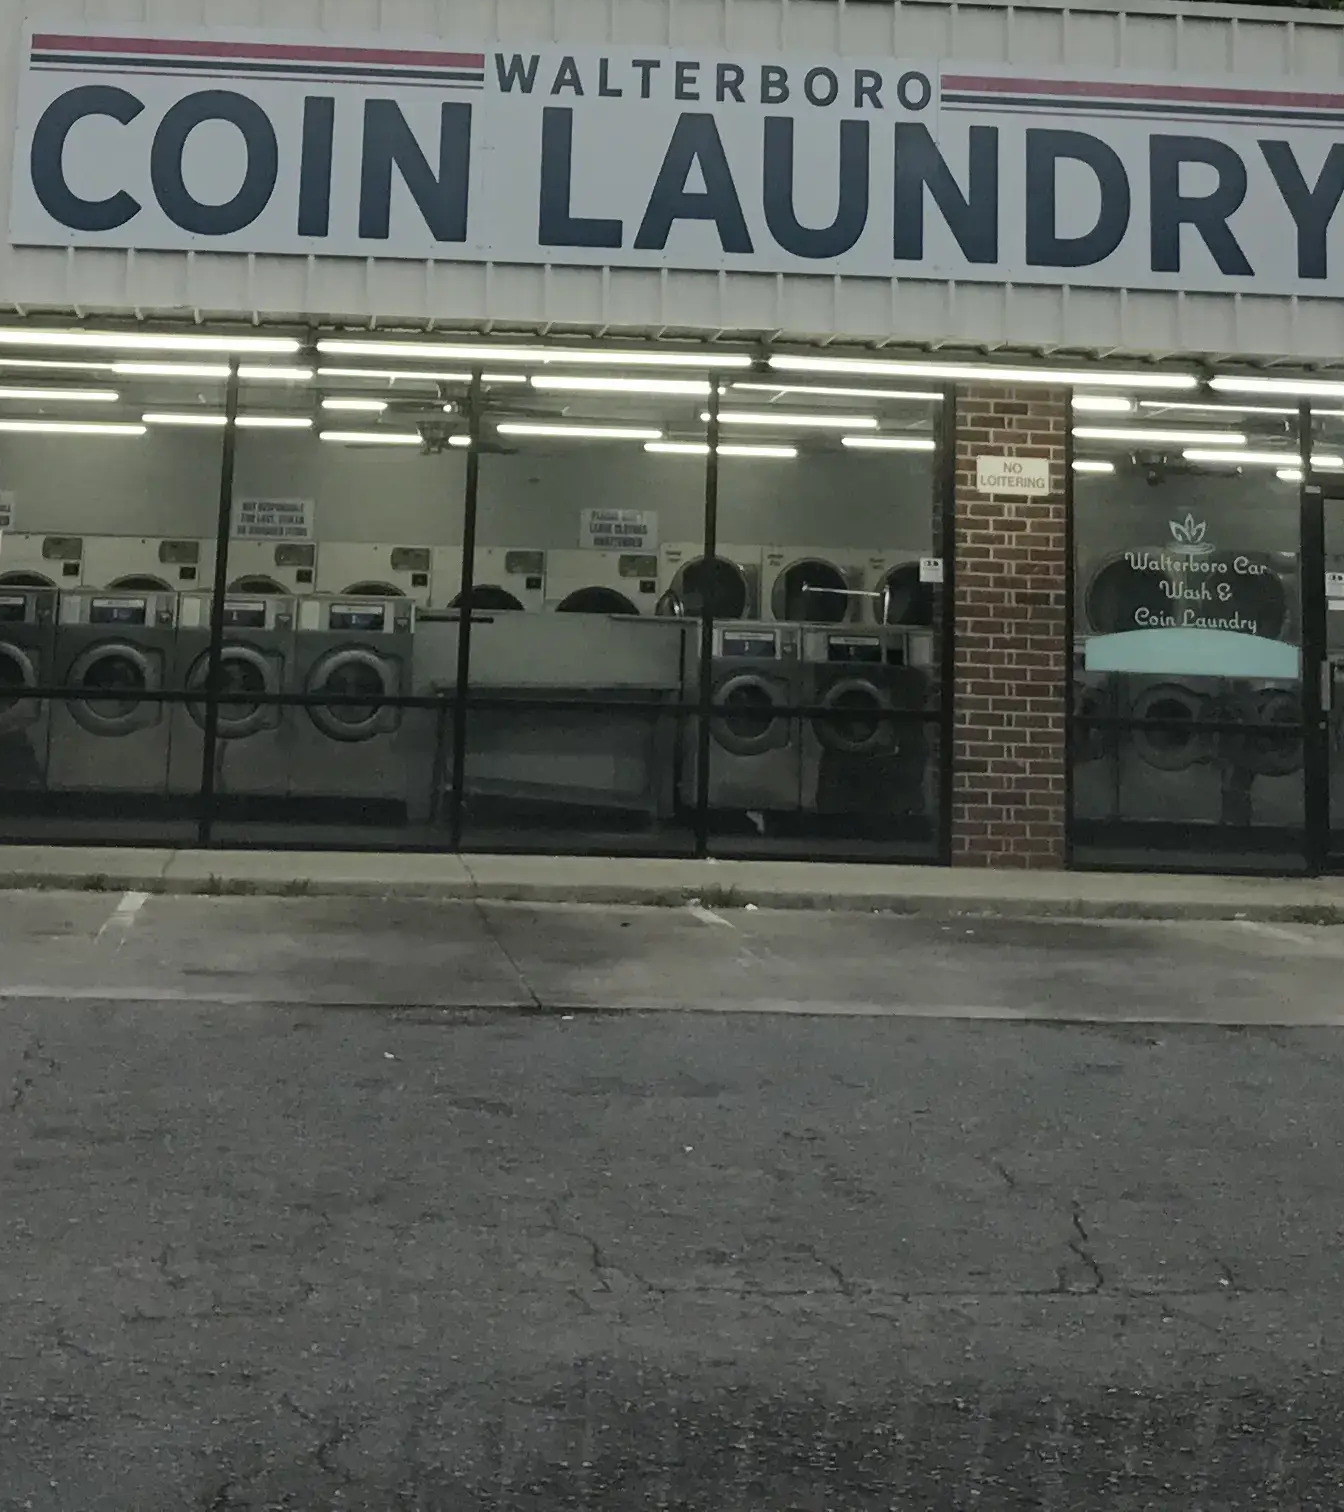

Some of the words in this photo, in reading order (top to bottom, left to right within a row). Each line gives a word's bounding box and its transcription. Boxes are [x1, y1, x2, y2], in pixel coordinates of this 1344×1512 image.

[493, 52, 935, 111] WALTERBORO
[29, 83, 474, 243] COIN
[1003, 461, 1023, 474] NO
[980, 474, 1045, 489] LOITERING
[1124, 551, 1228, 573] Walterboro
[1233, 555, 1268, 575] Car
[1159, 580, 1212, 601] Wash
[1217, 582, 1233, 602] &
[1134, 606, 1177, 627] Coin
[1181, 609, 1257, 634] Laundry
